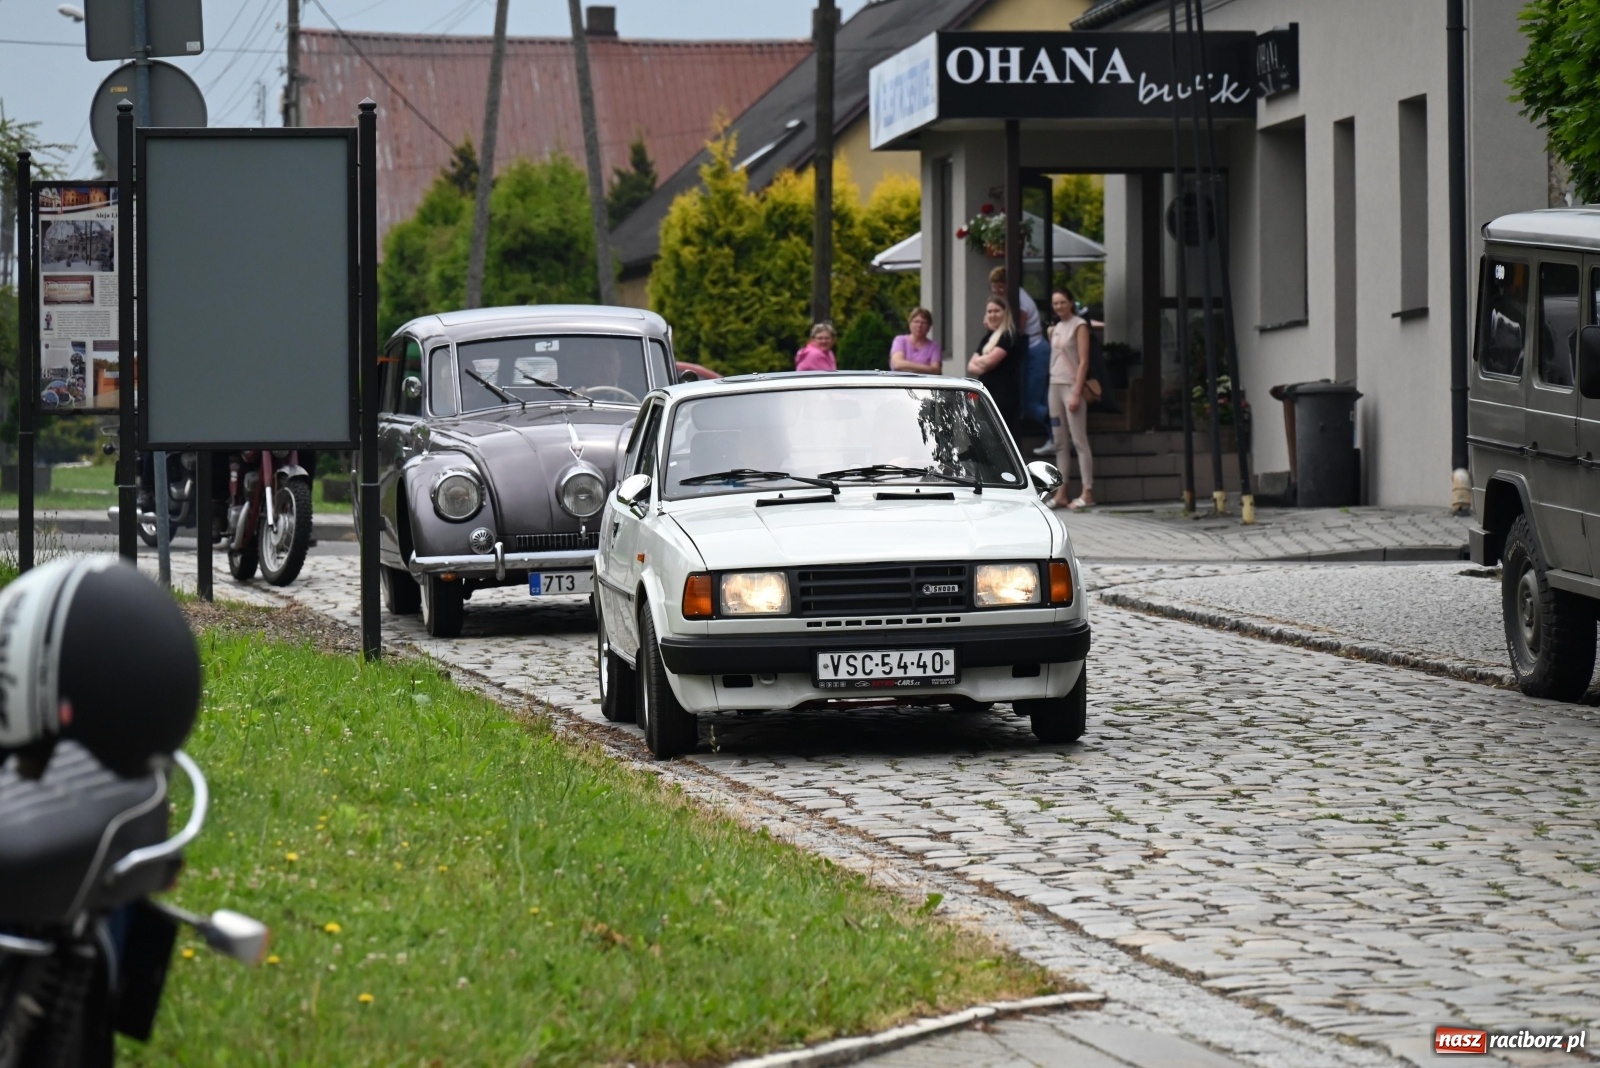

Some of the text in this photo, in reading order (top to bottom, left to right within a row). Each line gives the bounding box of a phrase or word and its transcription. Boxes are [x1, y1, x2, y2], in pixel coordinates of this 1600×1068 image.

[946, 46, 1135, 84] OHANA
[95, 211, 110, 219] Aleja
[544, 574, 576, 593] 7T3
